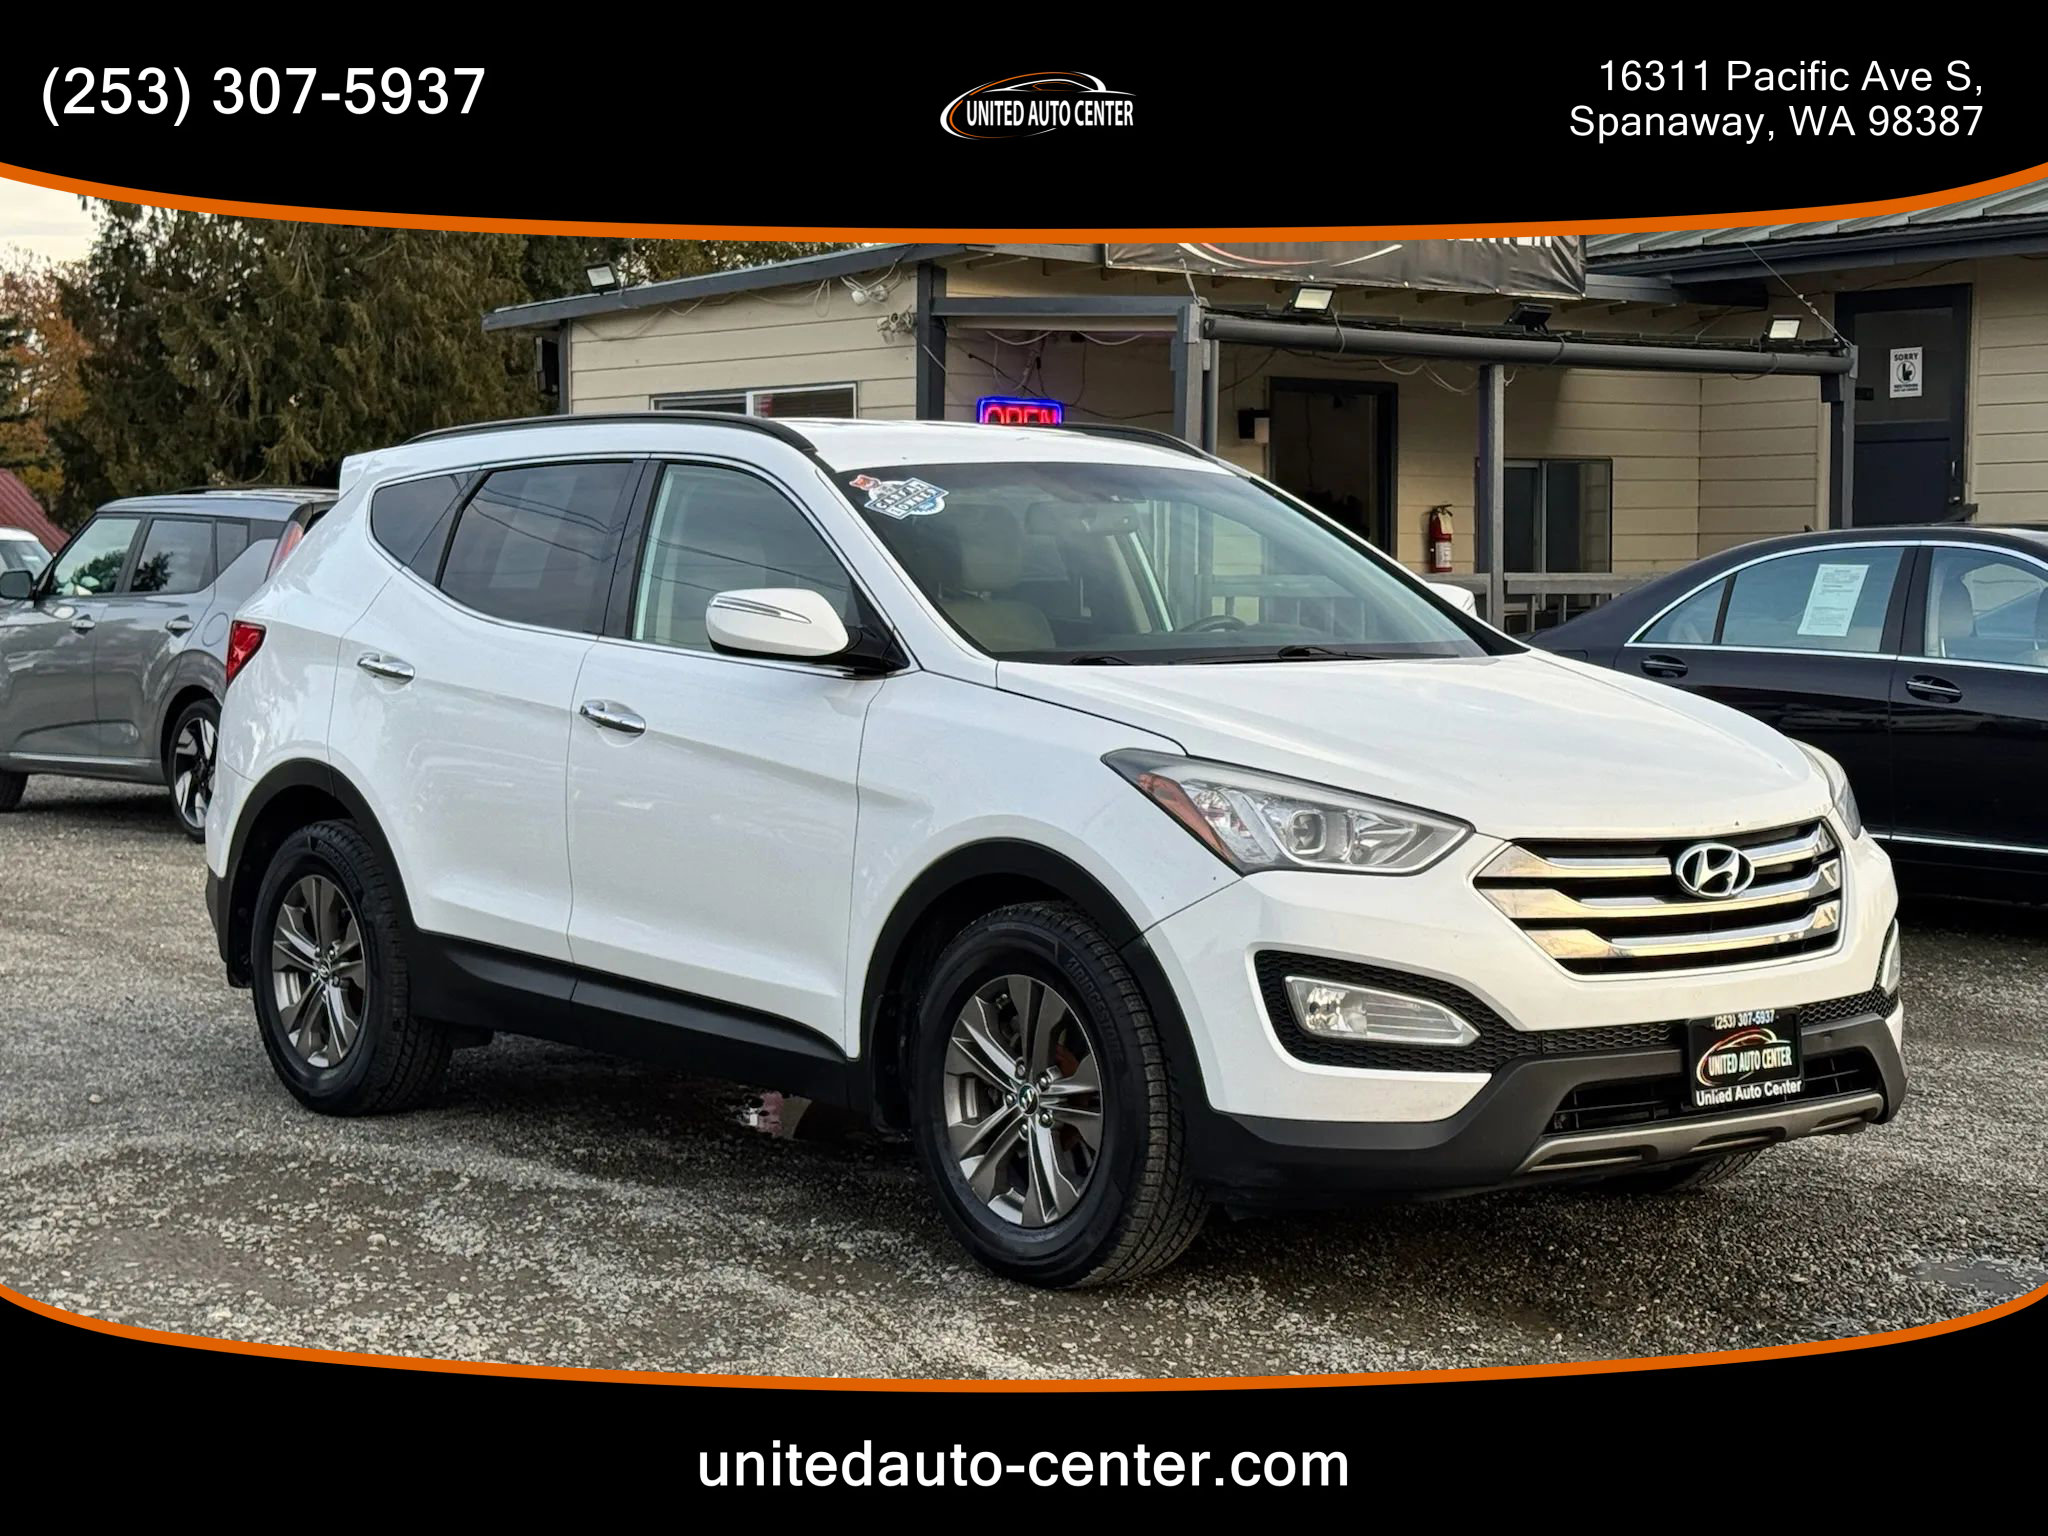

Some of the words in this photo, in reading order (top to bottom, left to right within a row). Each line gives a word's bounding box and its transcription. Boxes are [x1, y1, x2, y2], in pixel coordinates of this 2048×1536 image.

[1894, 352, 1919, 362] SORRY
[1714, 1014, 1736, 1030] (253)
[1738, 1009, 1775, 1027] 307-5937
[1708, 1053, 1738, 1076] UNITED
[1739, 1050, 1760, 1072] AUTO
[1762, 1046, 1792, 1069] CENTER
[1735, 1084, 1762, 1101] Auto
[1764, 1080, 1802, 1097] Center
